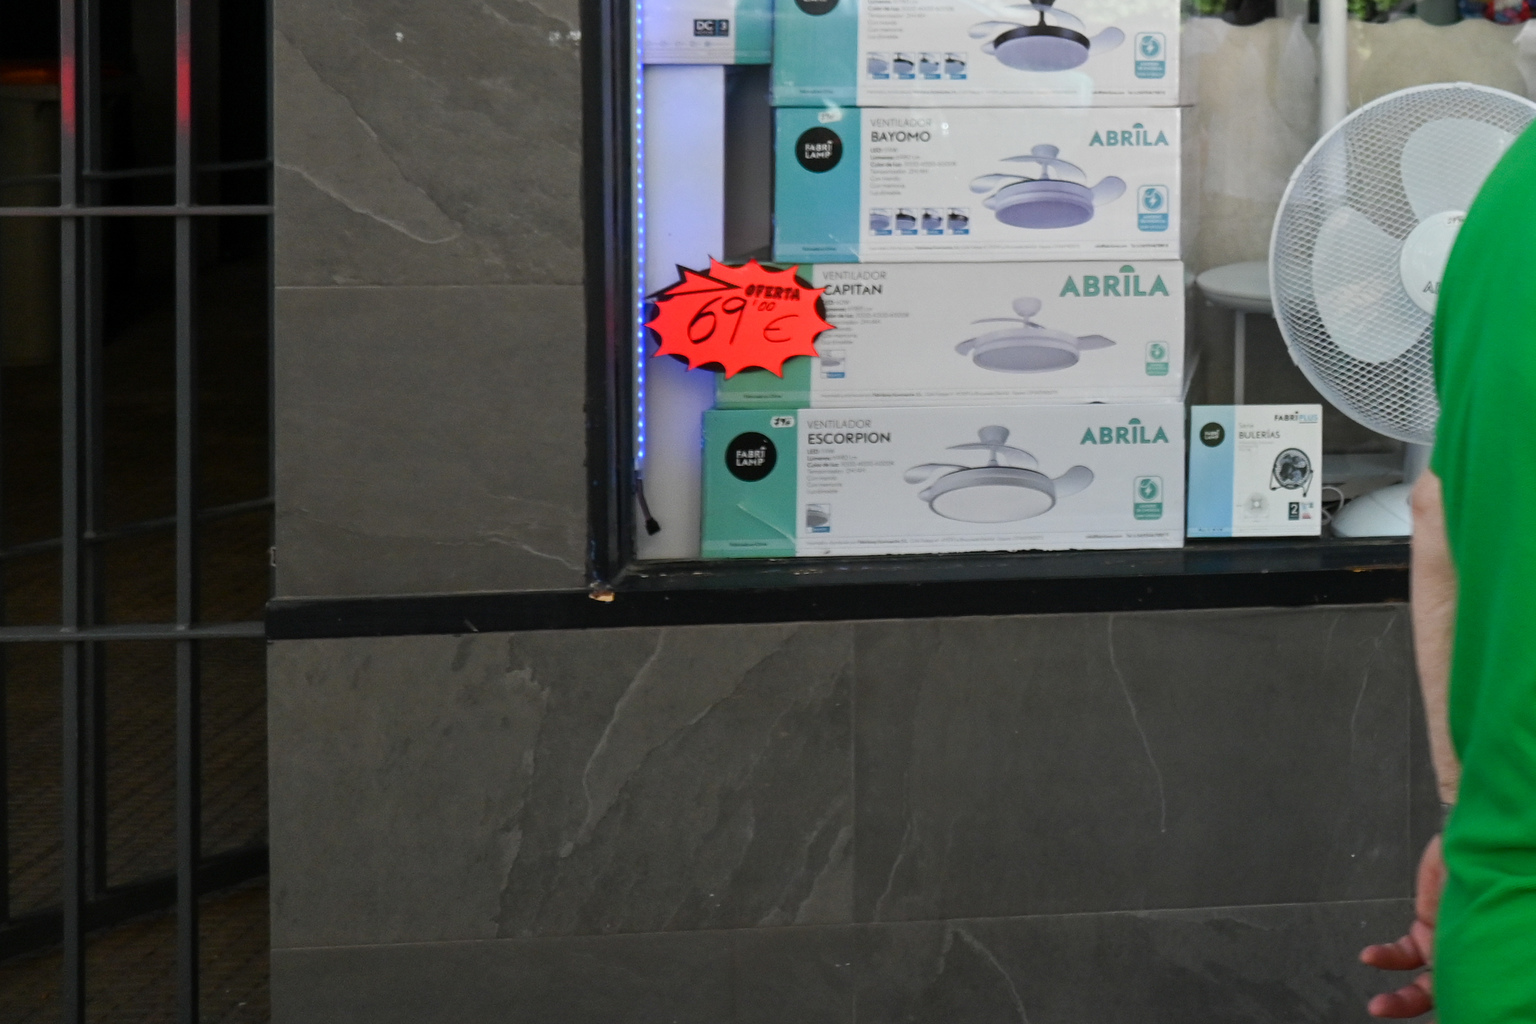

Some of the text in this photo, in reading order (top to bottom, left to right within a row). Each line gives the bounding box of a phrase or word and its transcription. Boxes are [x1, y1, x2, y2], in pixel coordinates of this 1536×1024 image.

[870, 118, 932, 127] VENTILADOR
[871, 131, 931, 142] BAYOMO
[822, 271, 887, 281] VENTILADOR
[745, 284, 800, 300] OFERTA
[807, 419, 872, 429] VENTILADOR
[807, 432, 891, 445] ESCORPION
[1290, 504, 1298, 515] 2
